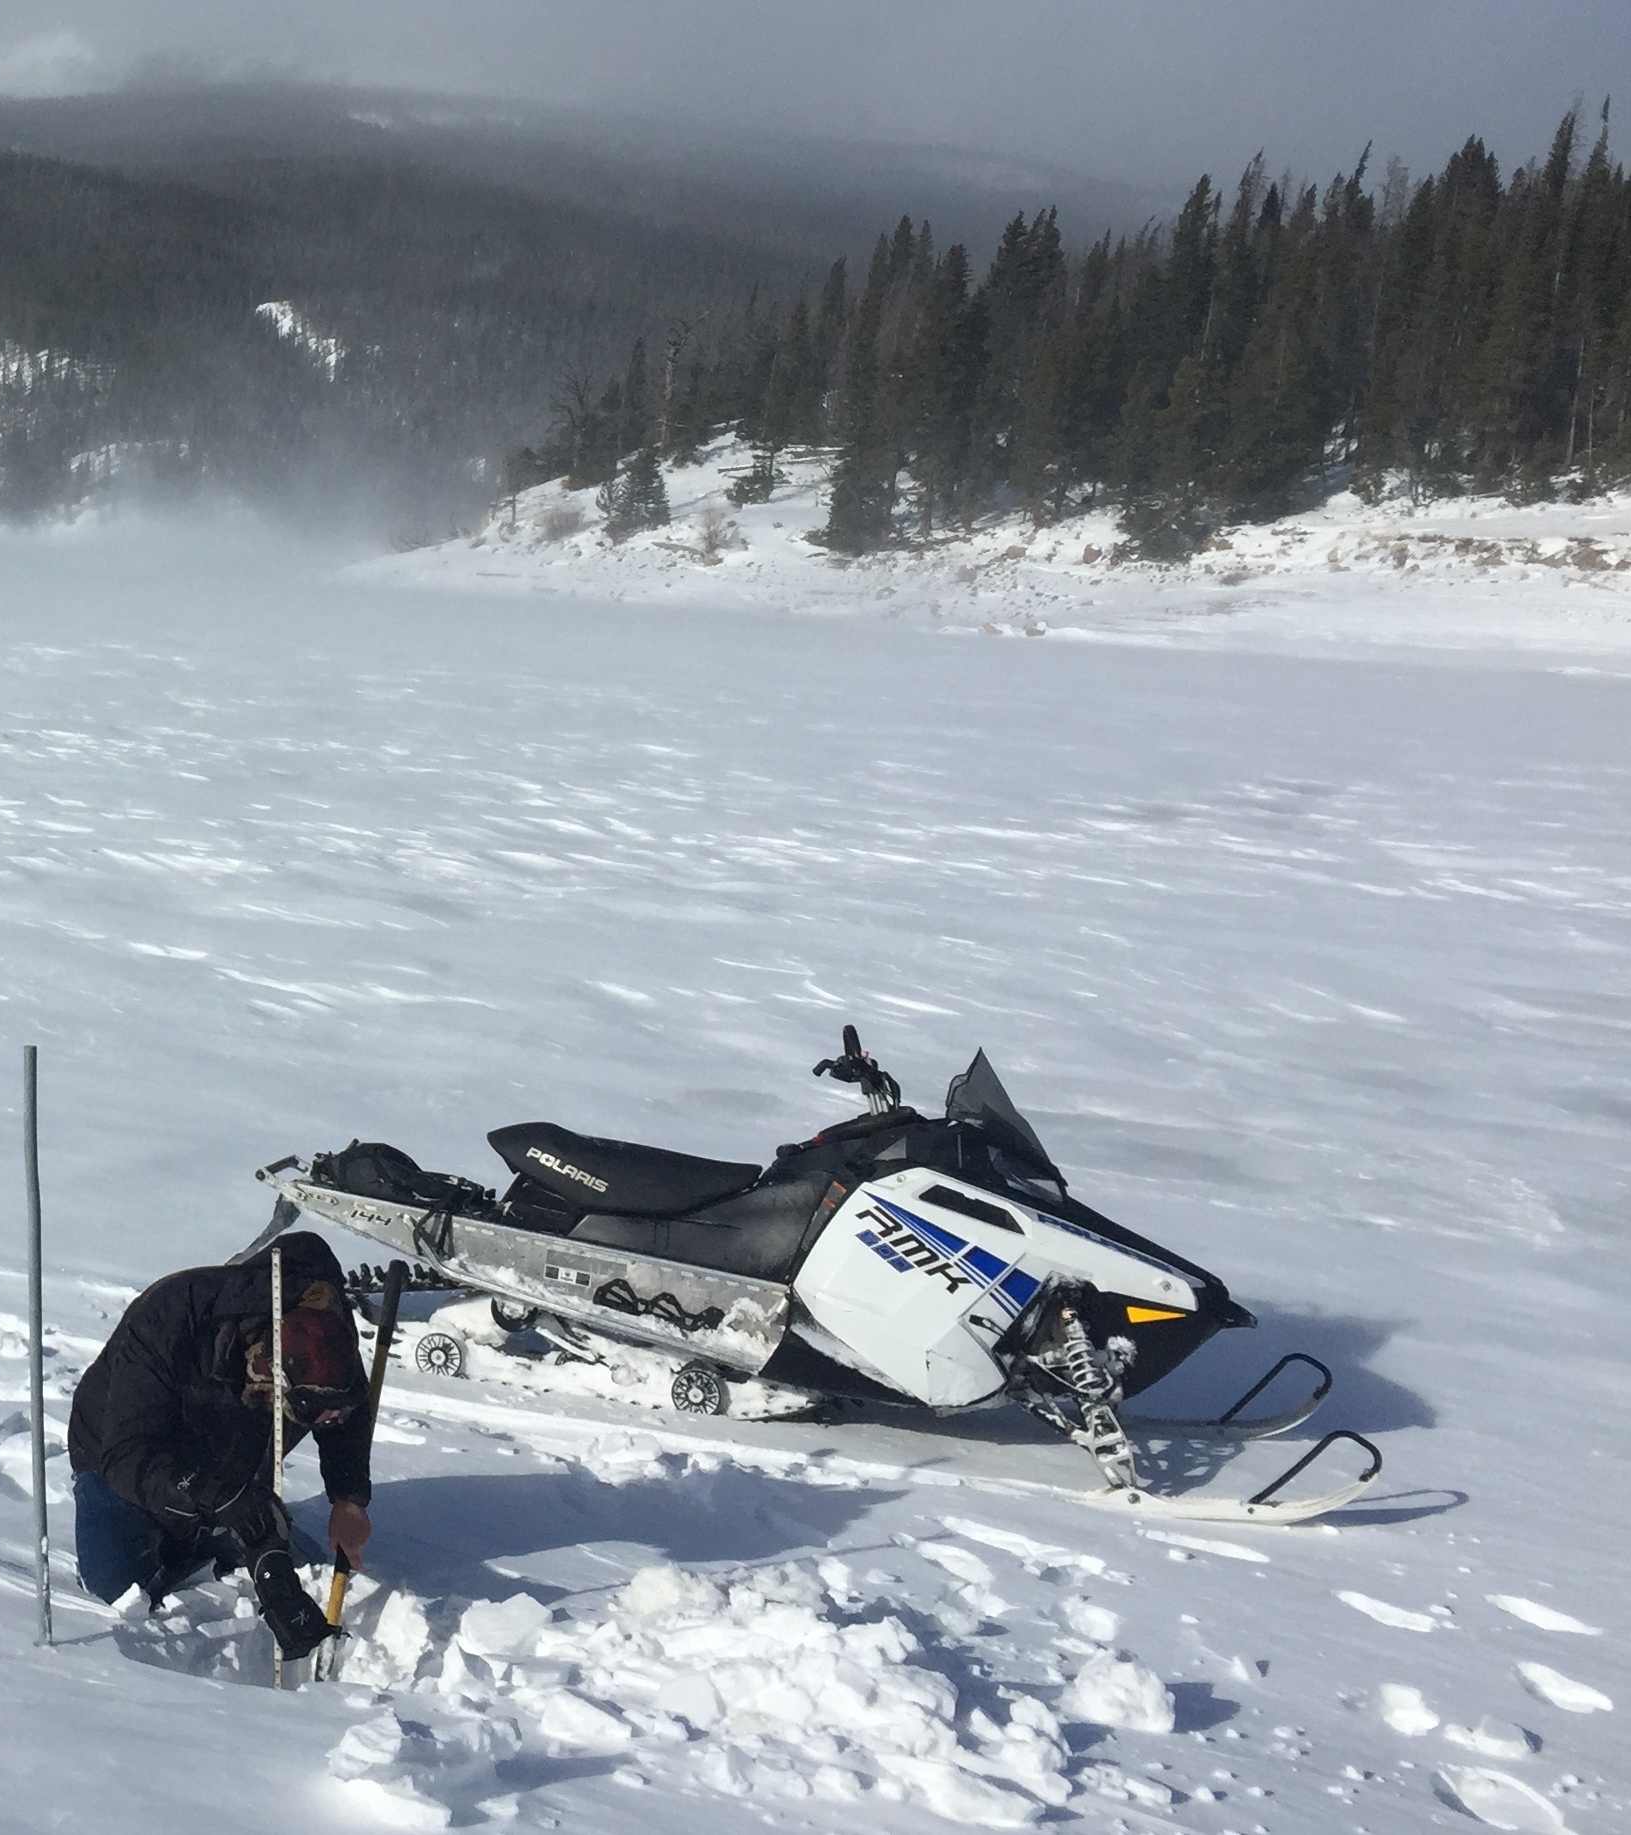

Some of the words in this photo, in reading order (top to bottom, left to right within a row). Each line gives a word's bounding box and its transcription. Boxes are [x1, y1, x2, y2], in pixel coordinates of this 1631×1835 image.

[525, 1146, 609, 1193] POLARIS
[351, 1210, 392, 1226] 144
[855, 1206, 973, 1294] RMK
